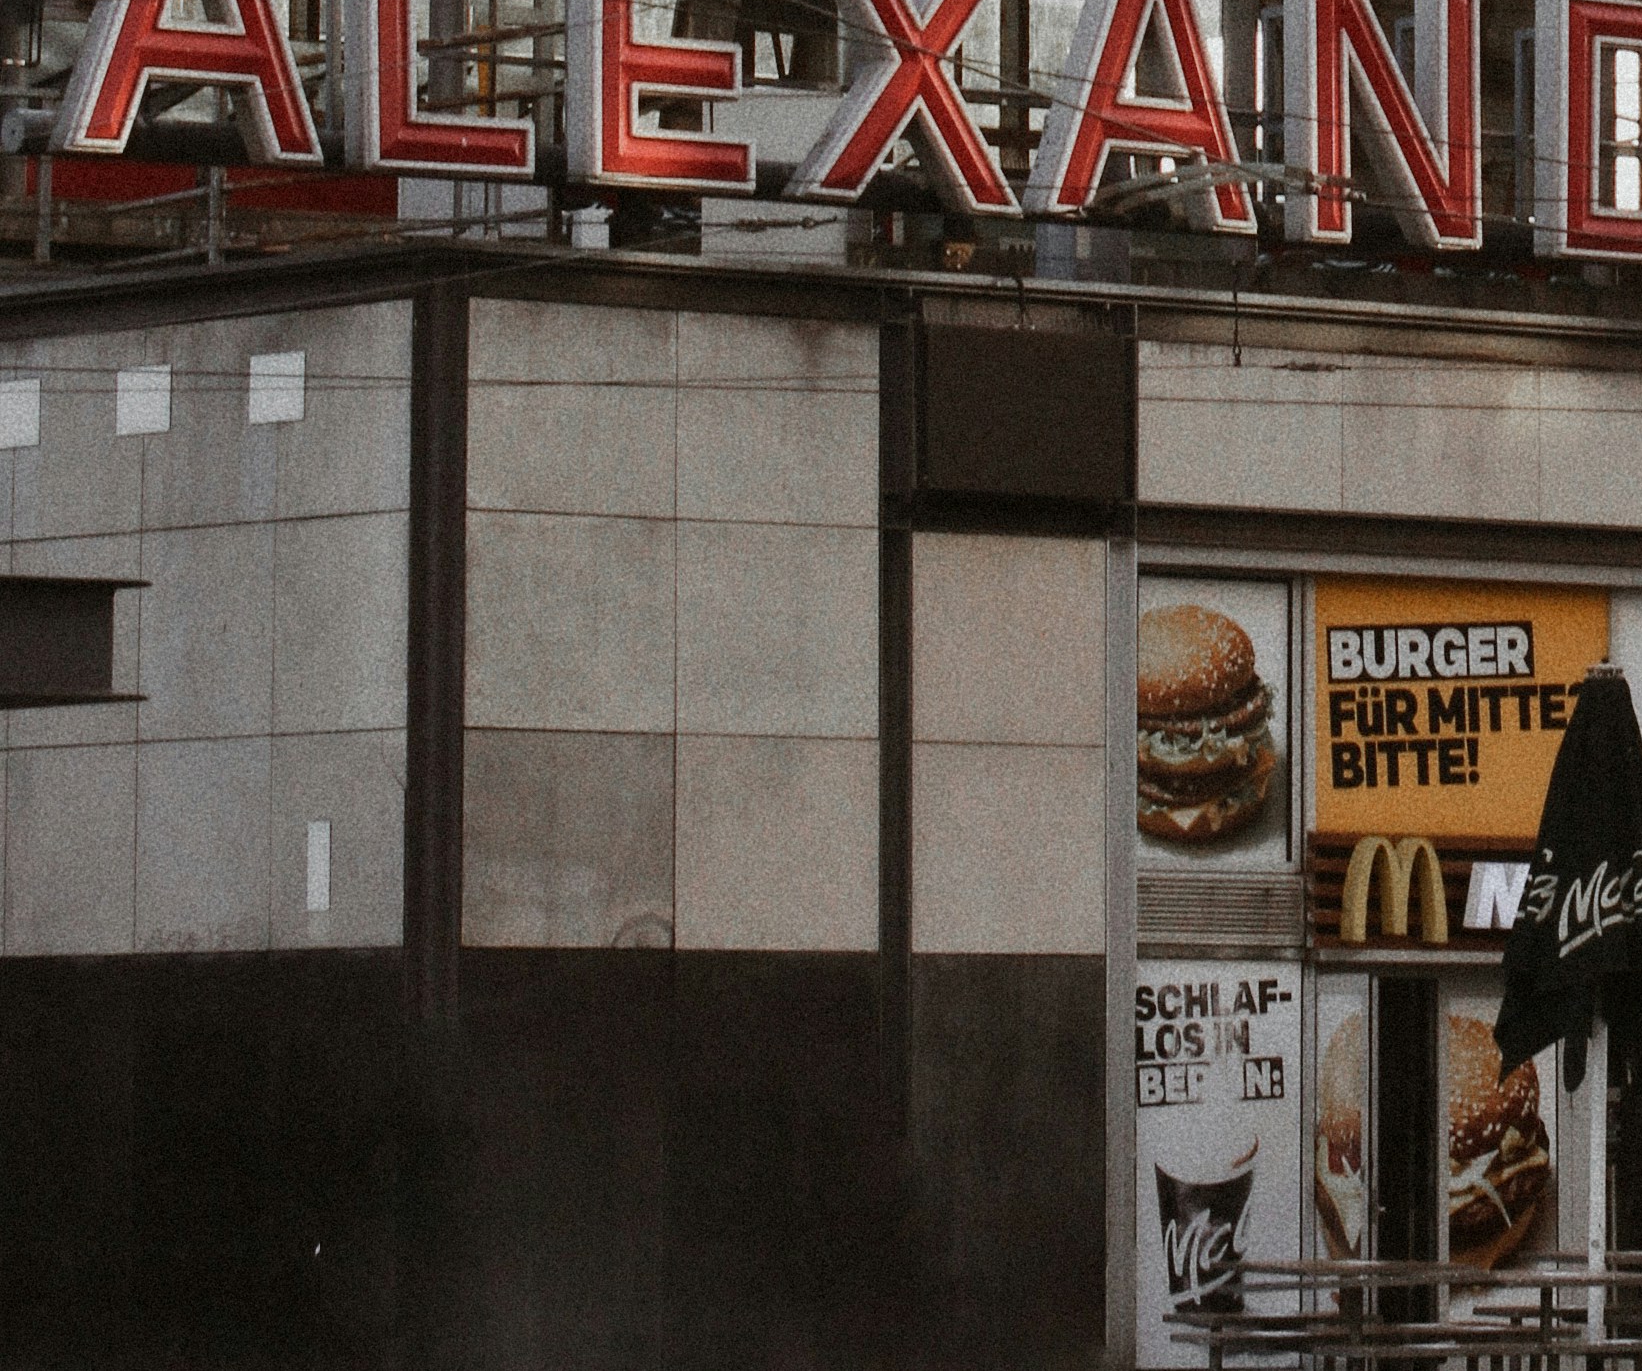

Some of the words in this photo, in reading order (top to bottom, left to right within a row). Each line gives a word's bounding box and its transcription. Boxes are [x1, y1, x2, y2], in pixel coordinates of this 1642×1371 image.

[1329, 625, 1531, 680] BURGER
[1330, 737, 1480, 790] BITTE!
[1135, 980, 1292, 1021] SCHLAF-
[1135, 1021, 1205, 1060] LOS
[1213, 1020, 1250, 1055] IN
[1138, 1060, 1283, 1106] BERN:
